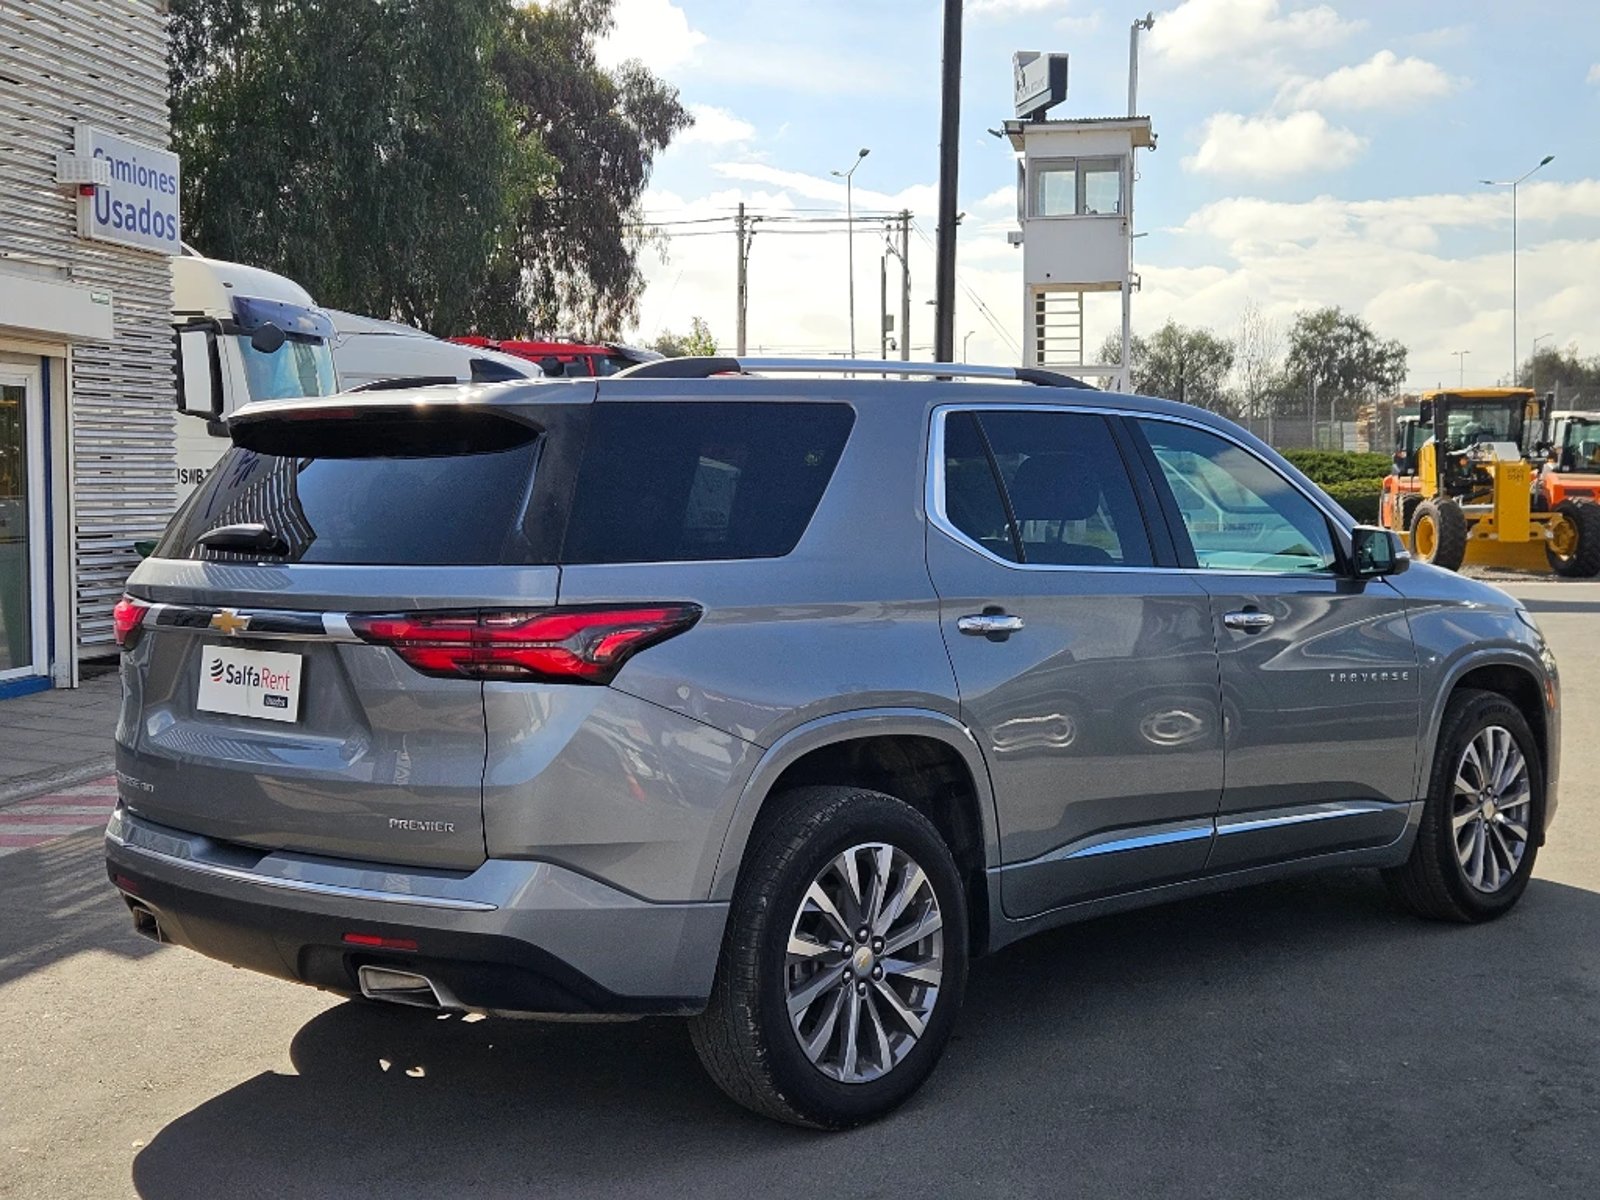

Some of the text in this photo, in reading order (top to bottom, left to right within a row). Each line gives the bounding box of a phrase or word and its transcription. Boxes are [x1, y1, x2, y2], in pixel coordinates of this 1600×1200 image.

[94, 187, 175, 241] Usados
[226, 663, 290, 691] SalfaRent
[1329, 671, 1409, 682] TRAVERSE
[388, 818, 455, 833] PREMIER
